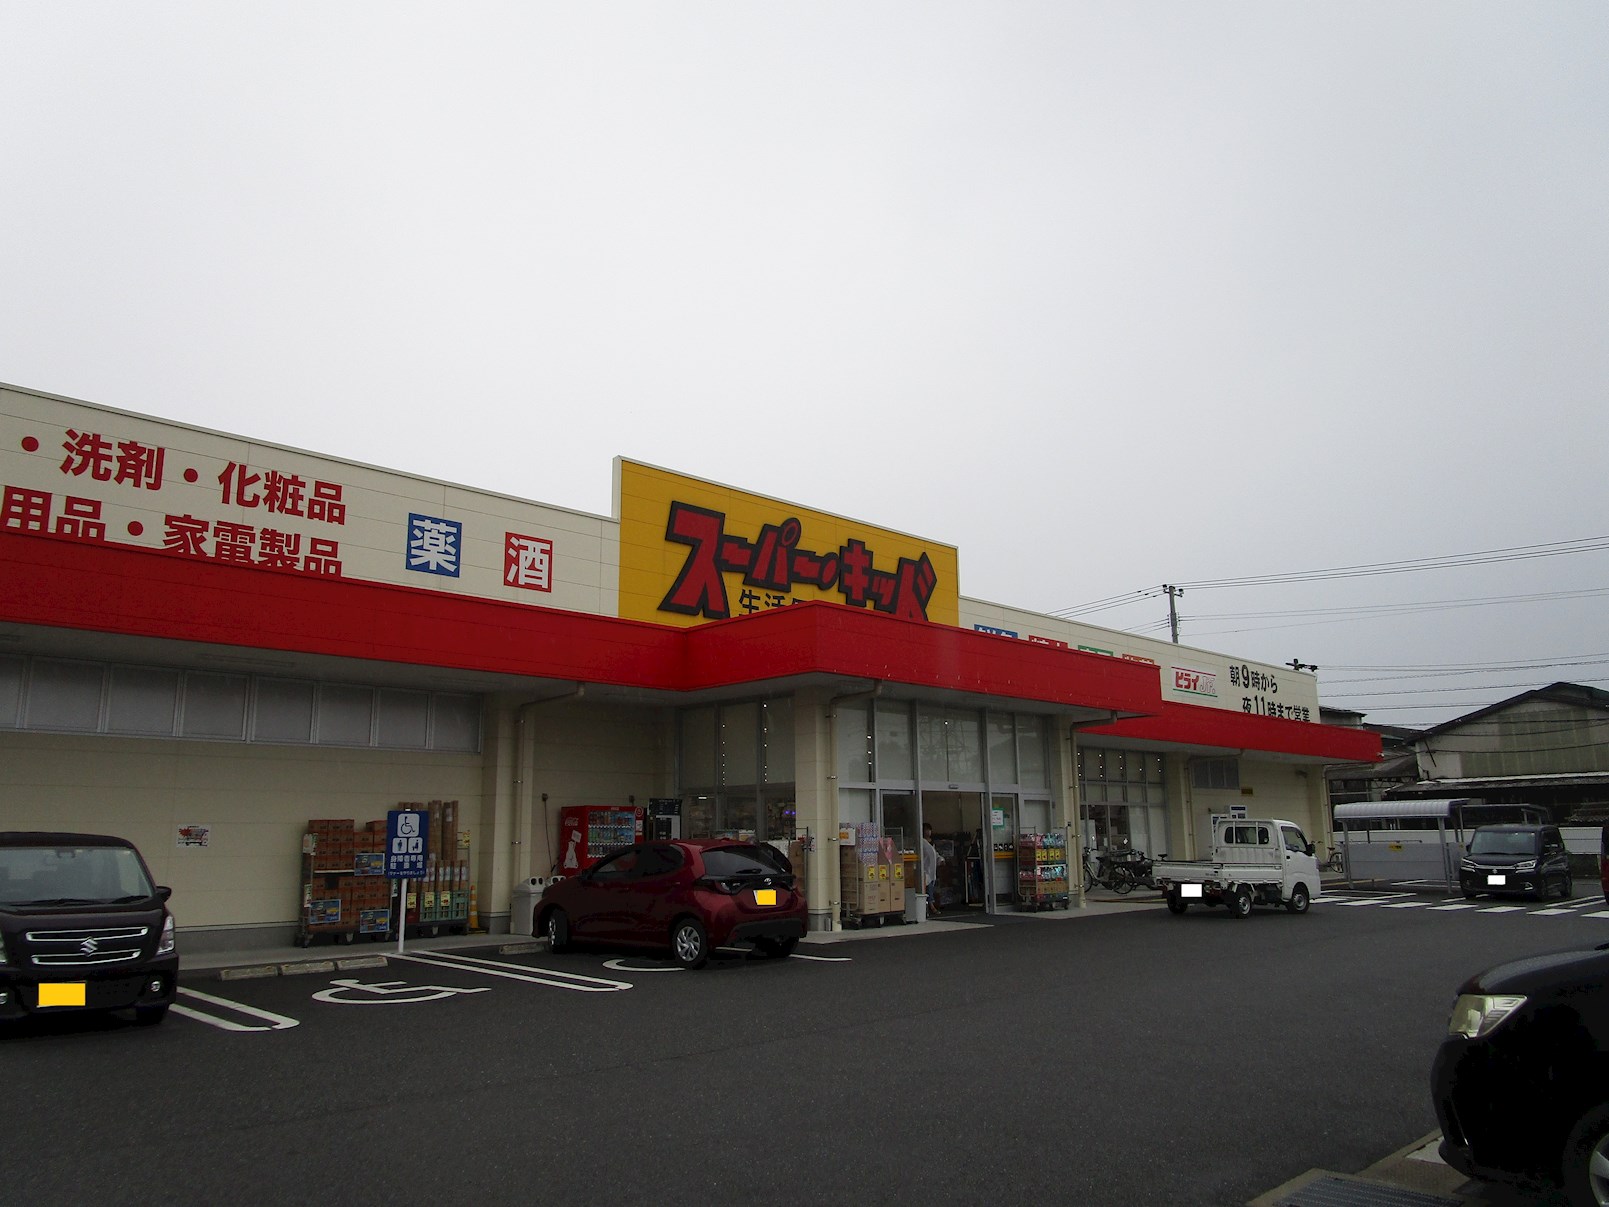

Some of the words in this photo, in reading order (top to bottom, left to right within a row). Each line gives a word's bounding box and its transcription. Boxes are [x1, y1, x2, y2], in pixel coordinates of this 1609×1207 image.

[409, 518, 458, 574] 薬
[506, 537, 551, 589] 酒
[1229, 664, 1278, 694] 朝9時から
